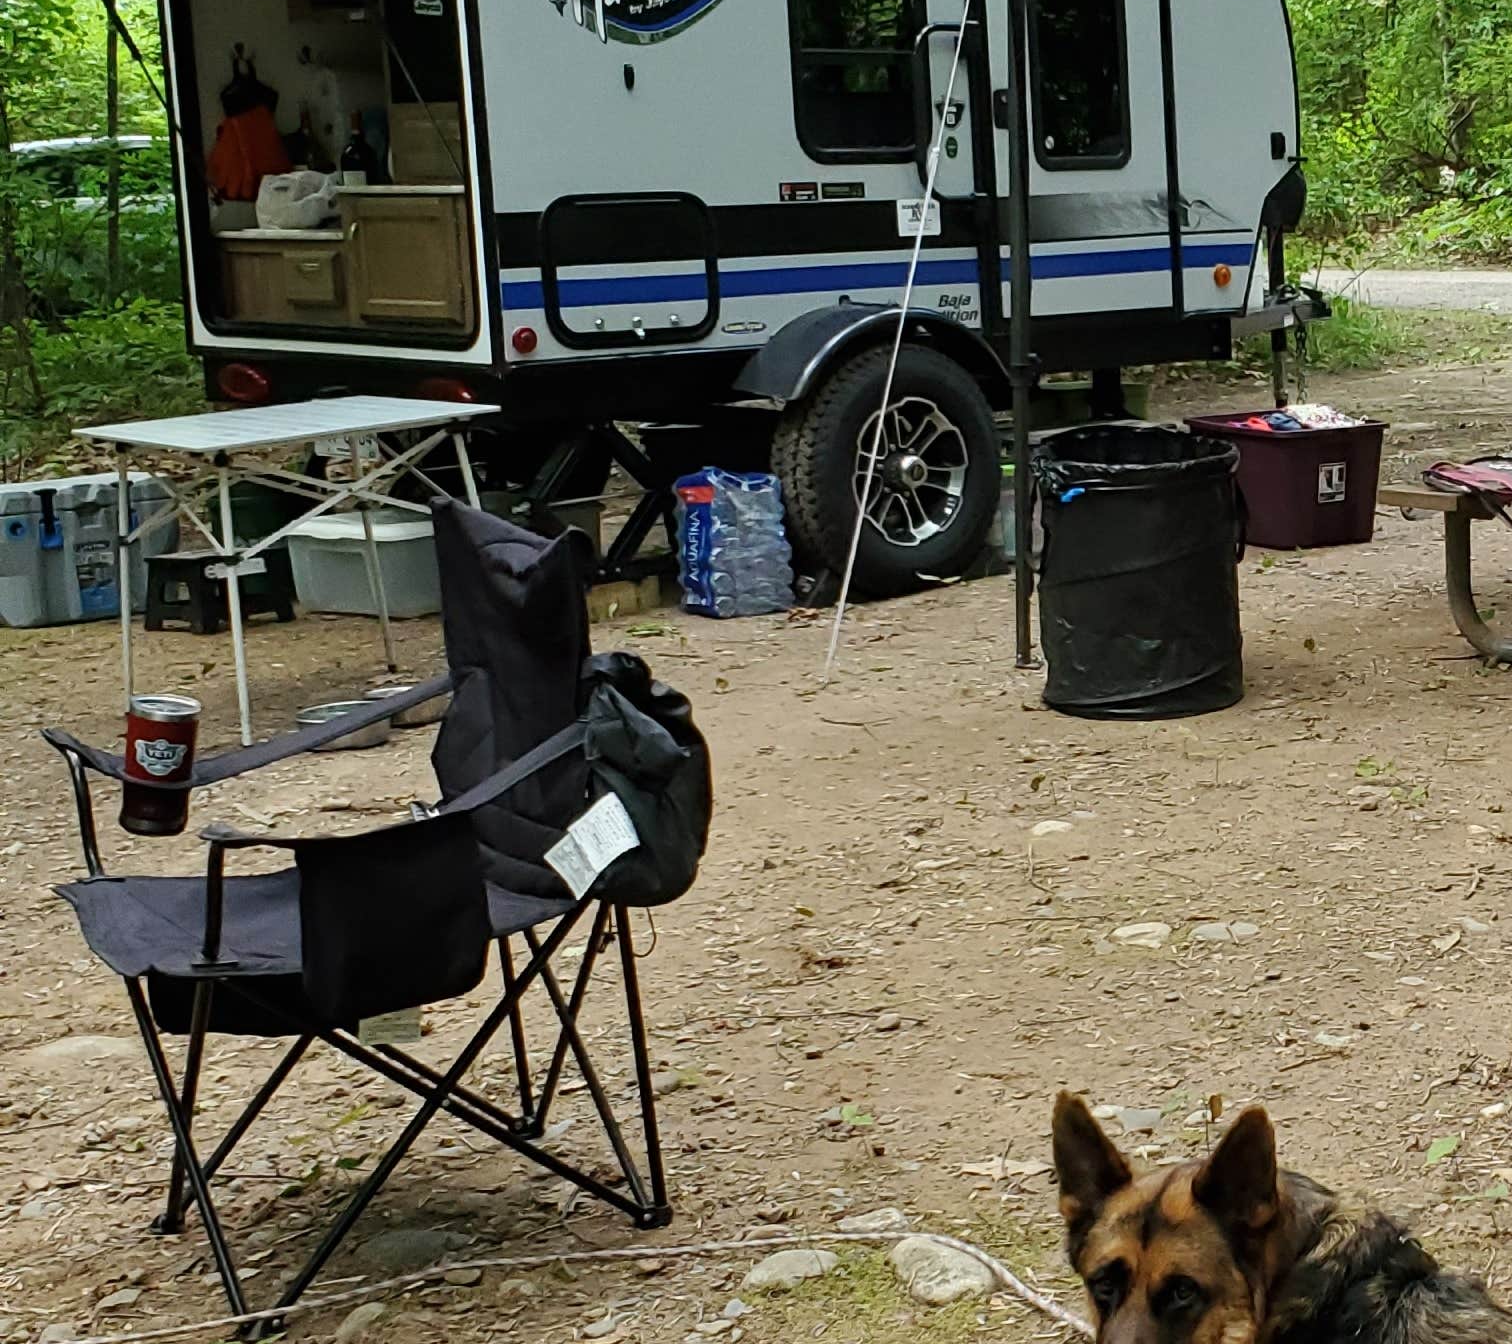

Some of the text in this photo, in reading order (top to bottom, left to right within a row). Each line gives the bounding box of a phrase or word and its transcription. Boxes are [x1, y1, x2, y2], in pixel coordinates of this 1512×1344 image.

[629, 3, 644, 14] by
[938, 294, 972, 309] Baja
[686, 511, 701, 581] AQUAFINA
[148, 750, 173, 759] YETI
